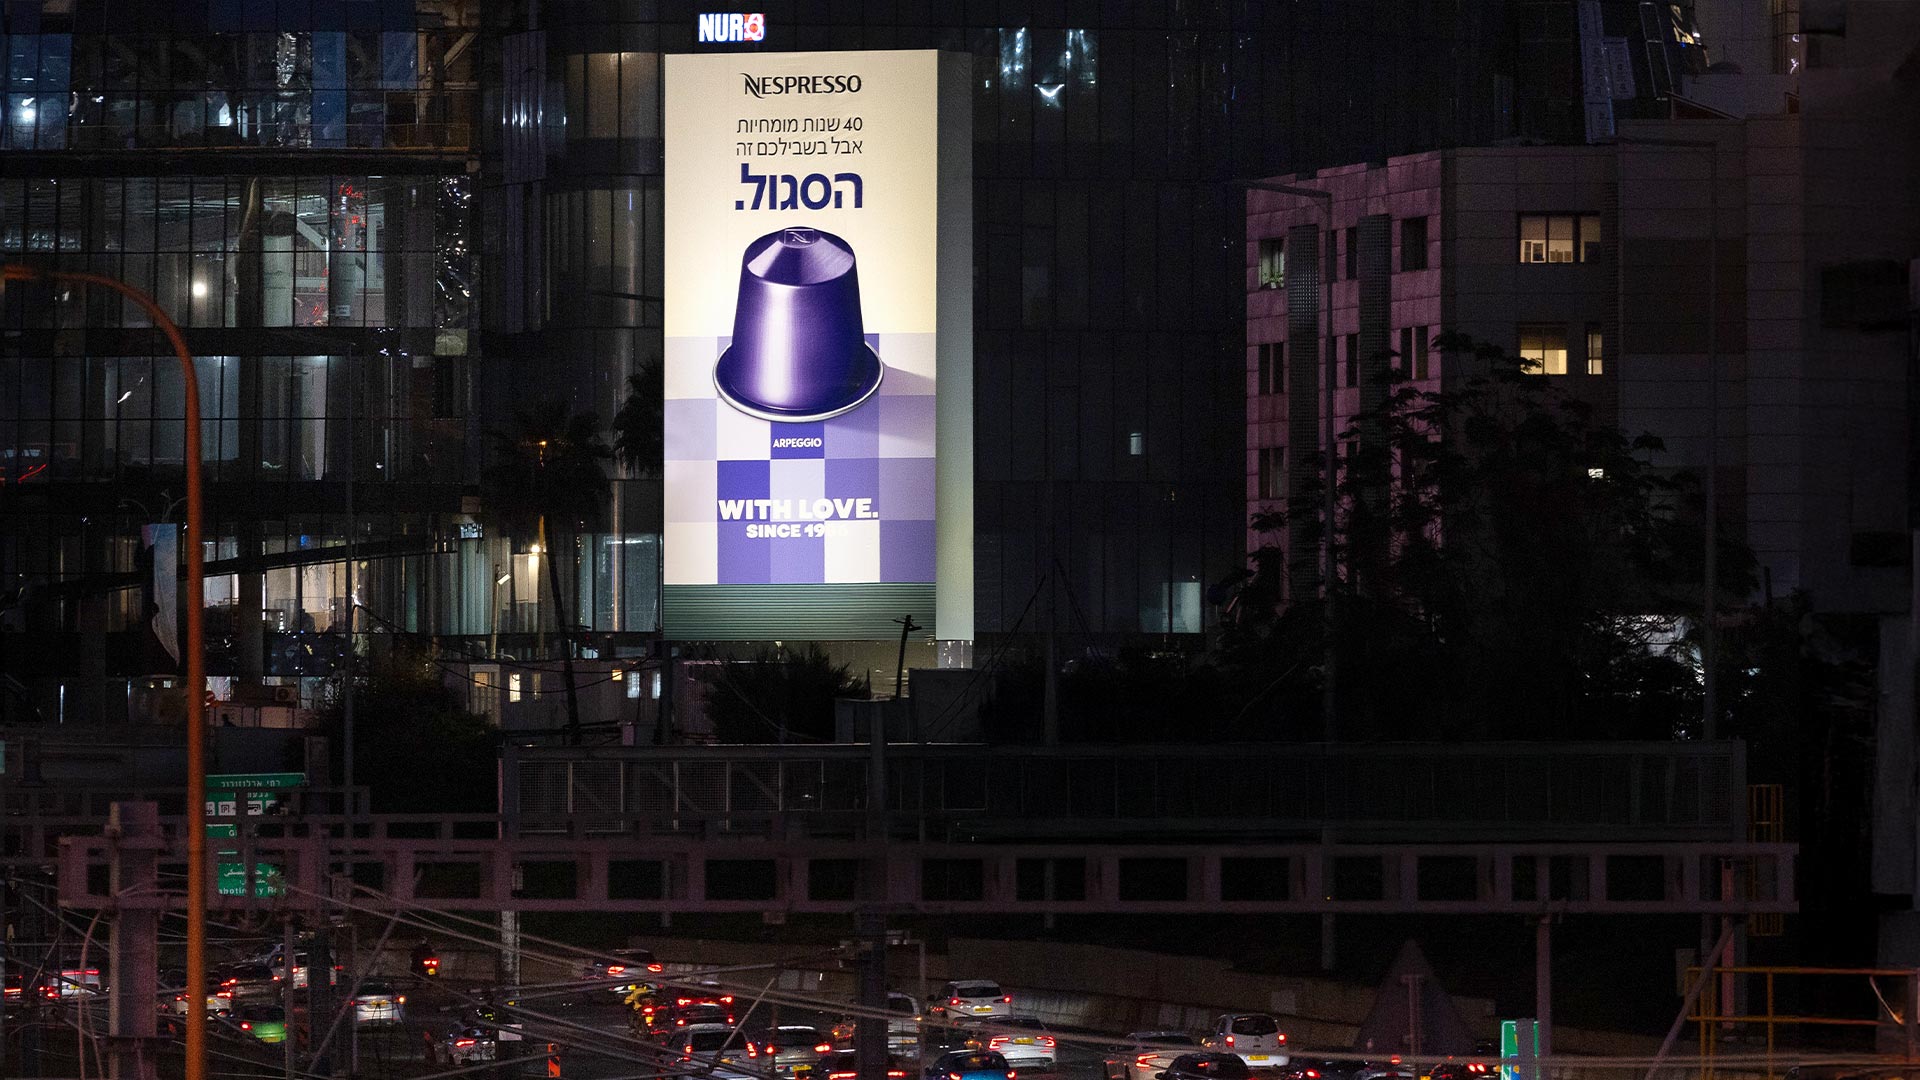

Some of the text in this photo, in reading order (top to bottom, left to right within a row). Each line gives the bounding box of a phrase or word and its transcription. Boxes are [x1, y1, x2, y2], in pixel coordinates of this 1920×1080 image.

[740, 72, 862, 99] NESPRESSO
[736, 116, 863, 134] 40 שנות מומחיות
[736, 137, 863, 156] אבל בשבילכם זה
[735, 163, 863, 211] הסגול.
[772, 438, 822, 448] ARPEGGIO
[718, 498, 879, 520] WITH LOVE.
[746, 524, 801, 539] SINCE
